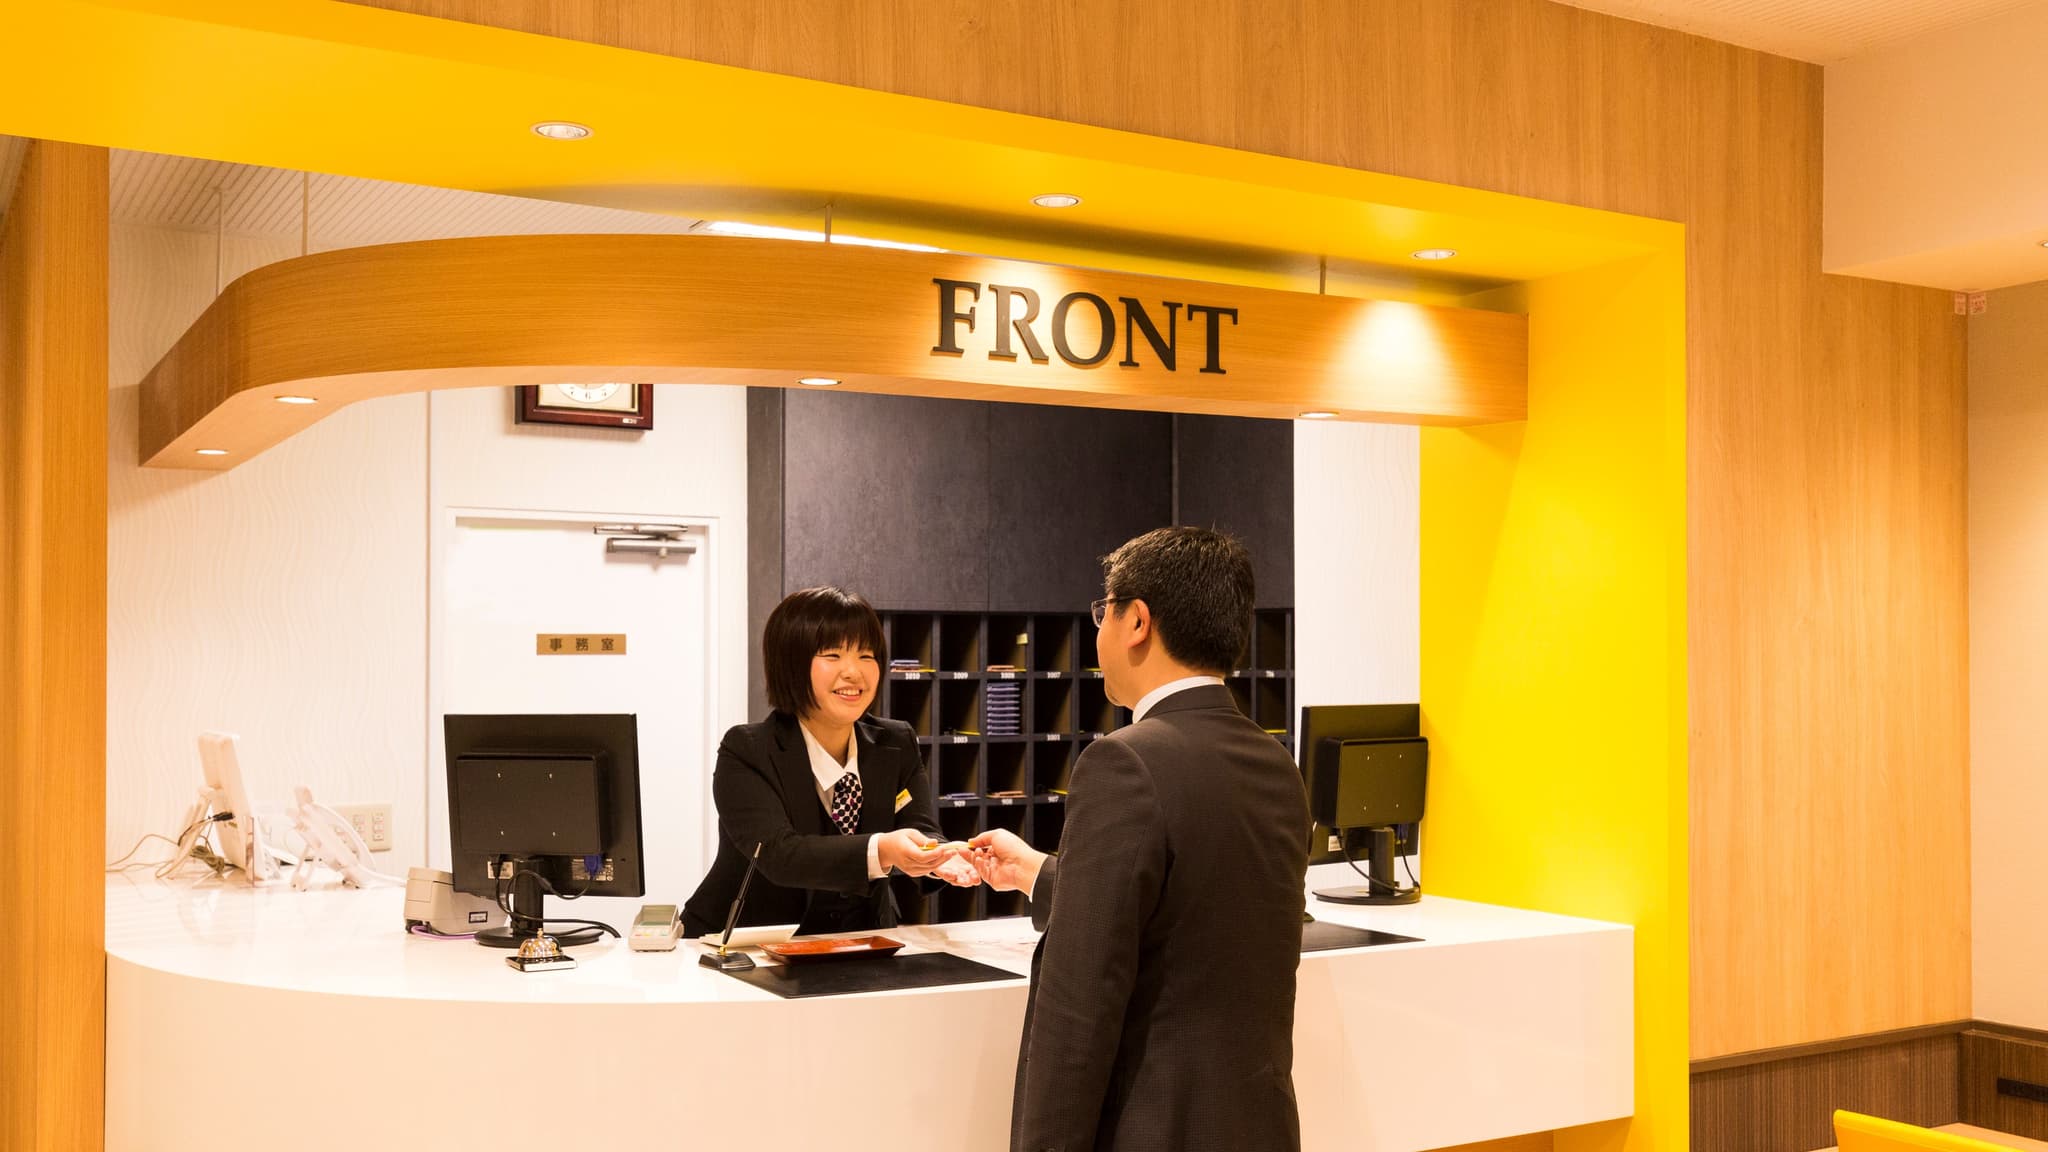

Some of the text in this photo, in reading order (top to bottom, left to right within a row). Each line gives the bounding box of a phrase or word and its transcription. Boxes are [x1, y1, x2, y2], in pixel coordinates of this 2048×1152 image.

[932, 278, 1238, 375] FRONT
[549, 637, 614, 652] 事務室
